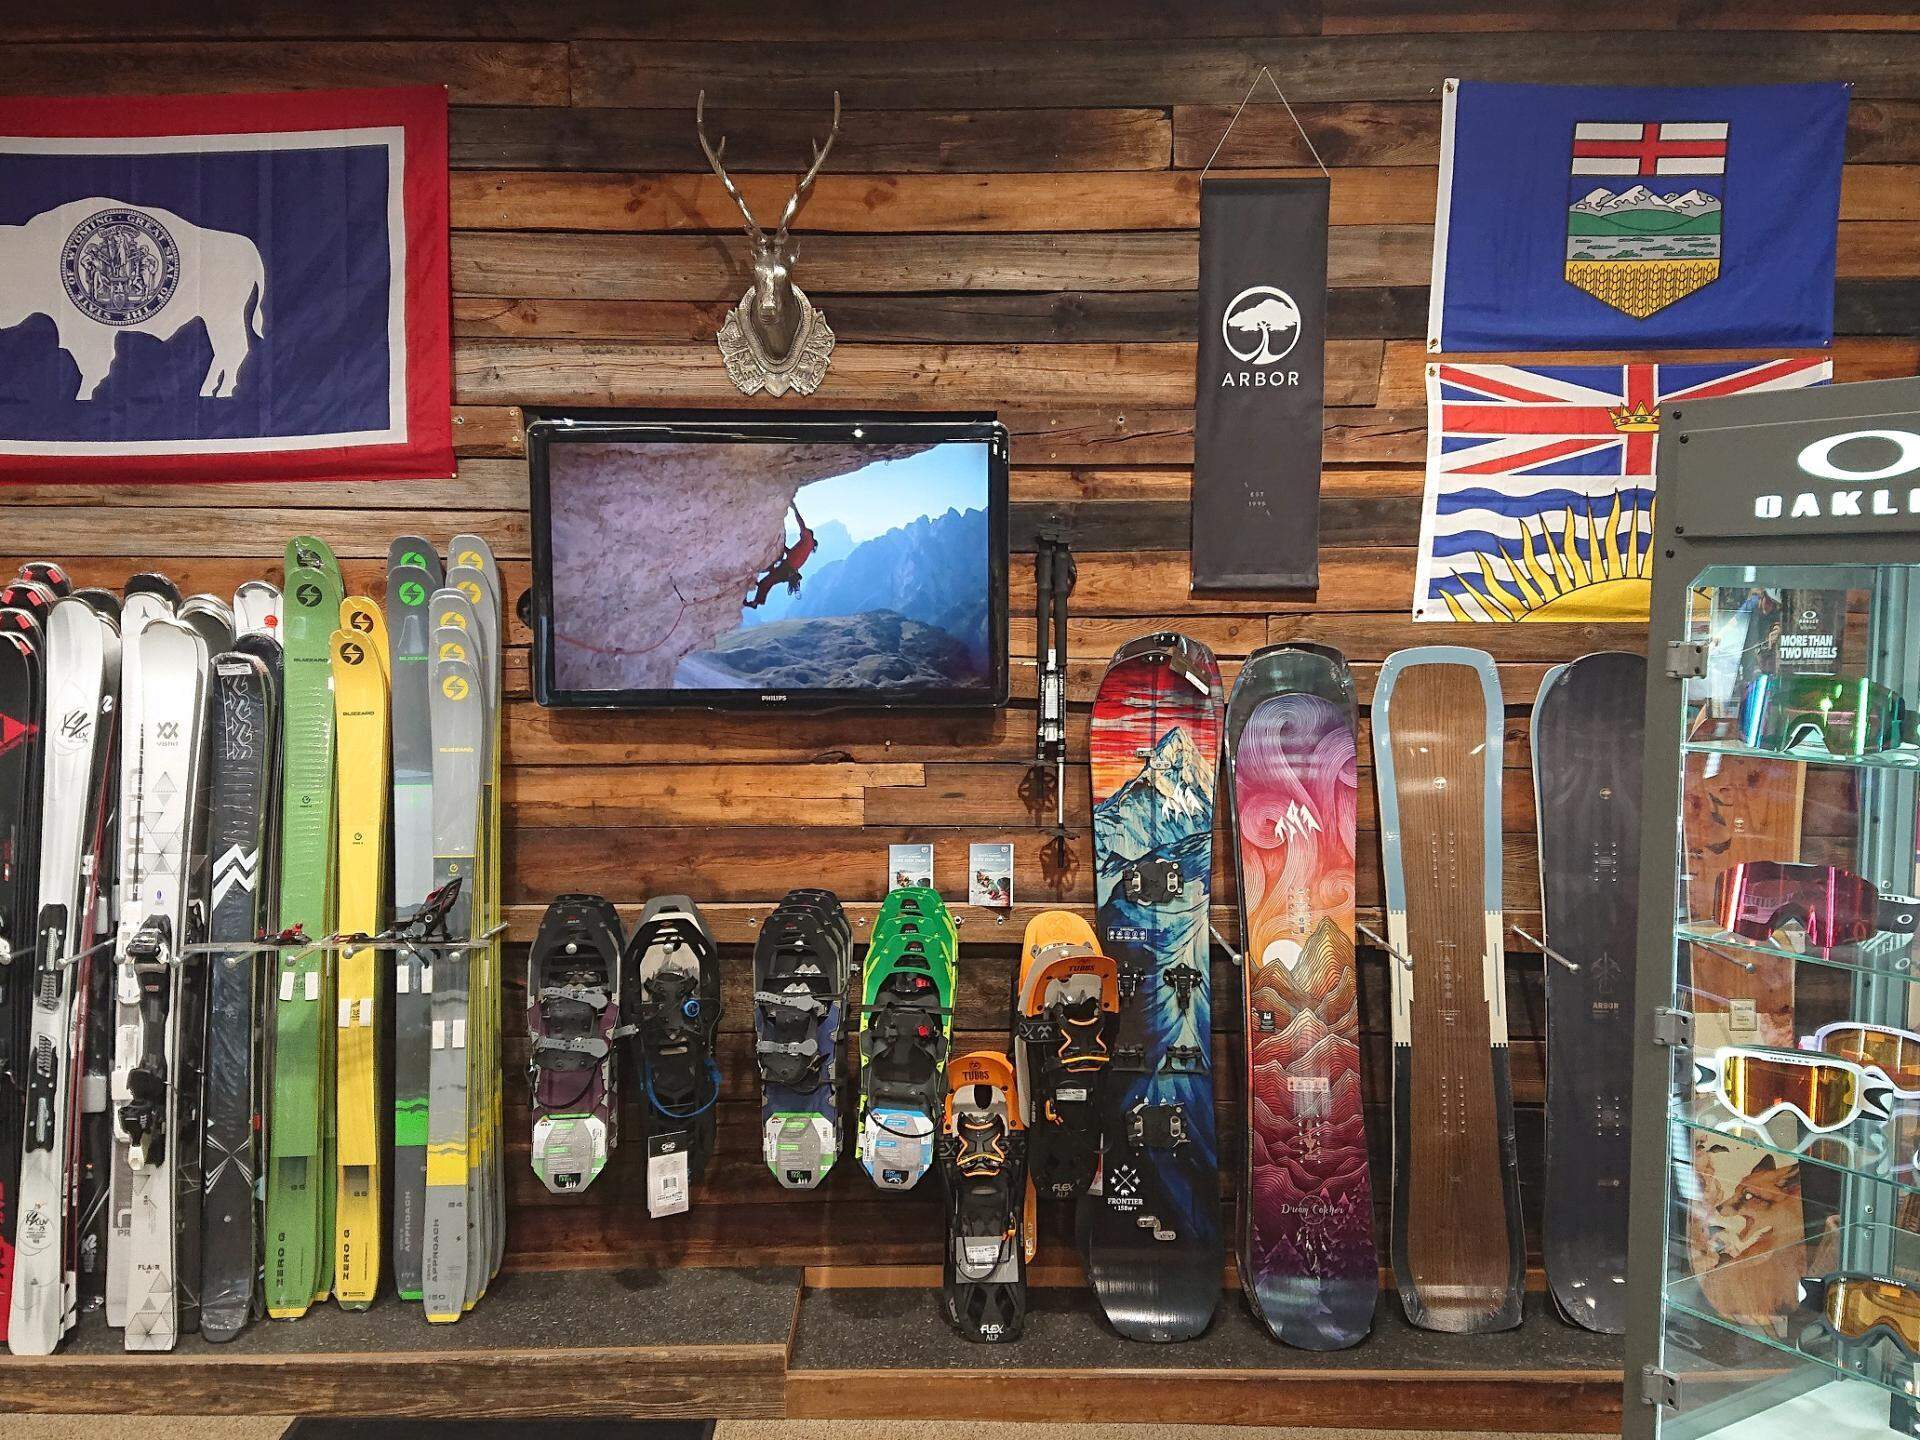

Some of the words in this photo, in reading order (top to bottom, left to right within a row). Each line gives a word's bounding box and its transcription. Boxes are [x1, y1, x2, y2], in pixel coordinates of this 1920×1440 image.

[127, 214, 165, 241] GREAT
[67, 215, 113, 260] WYOMING
[165, 246, 175, 279] SEAL
[67, 269, 76, 285] OF
[157, 286, 169, 302] OF
[77, 293, 111, 320] STATE
[123, 306, 150, 320] THE
[1222, 371, 1300, 387] ARBOR
[1780, 635, 1808, 647] MORE
[1808, 635, 1833, 647] THAN
[1780, 647, 1801, 659] TWO
[1803, 647, 1837, 659] WHEELS
[1069, 964, 1096, 972] TUBBS
[962, 1070, 990, 1081] TUBBS
[1051, 1183, 1074, 1192] FLEX
[1107, 1198, 1143, 1206] FRONTIER
[1281, 1203, 1309, 1217] Dream
[278, 1232, 286, 1242] G
[343, 1229, 350, 1238] G
[276, 1247, 286, 1288] ZERO
[342, 1243, 350, 1281] ZERO
[1873, 1276, 1907, 1287] OAKLEY
[980, 1324, 1004, 1334] FLEX
